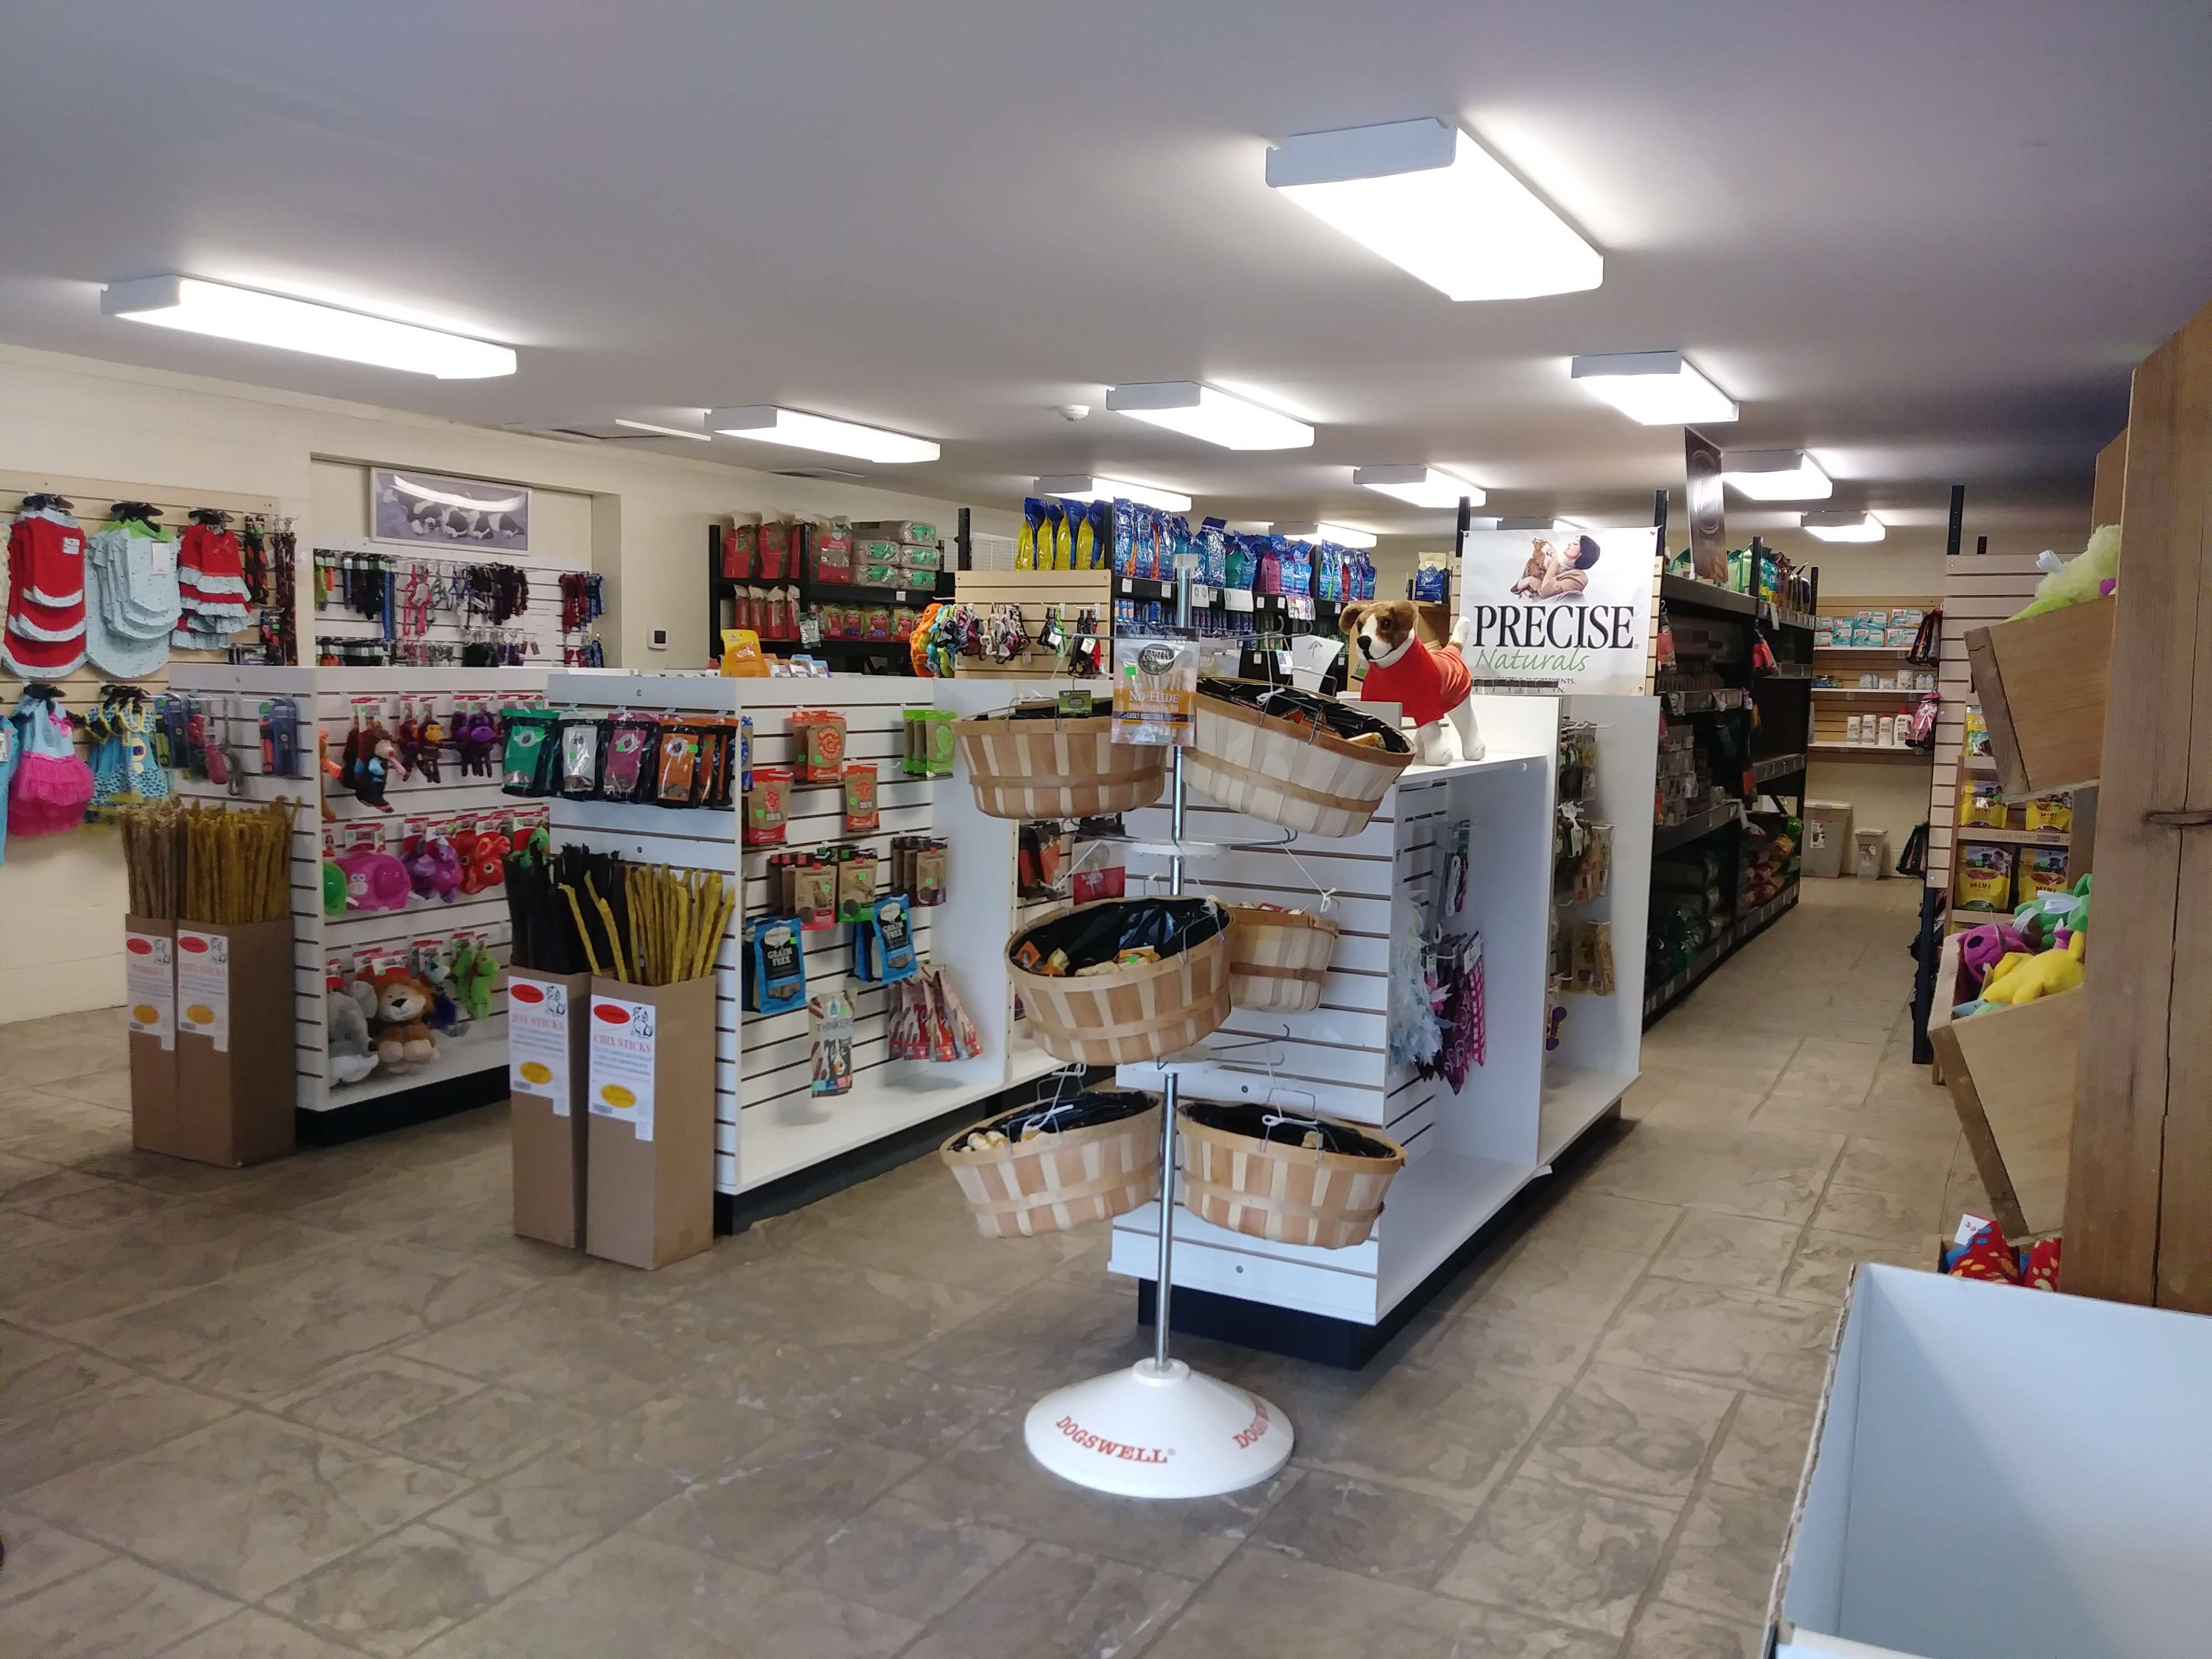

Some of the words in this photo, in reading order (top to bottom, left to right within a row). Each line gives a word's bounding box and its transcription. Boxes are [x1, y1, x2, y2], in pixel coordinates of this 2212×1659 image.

[1473, 605, 1634, 649] PRECISE
[1475, 646, 1590, 672] Naturals
[767, 947, 793, 959] GRAIN
[772, 956, 792, 967] FREE
[619, 1039, 651, 1052] STICKS
[1055, 1415, 1168, 1464] DOGSWELL
